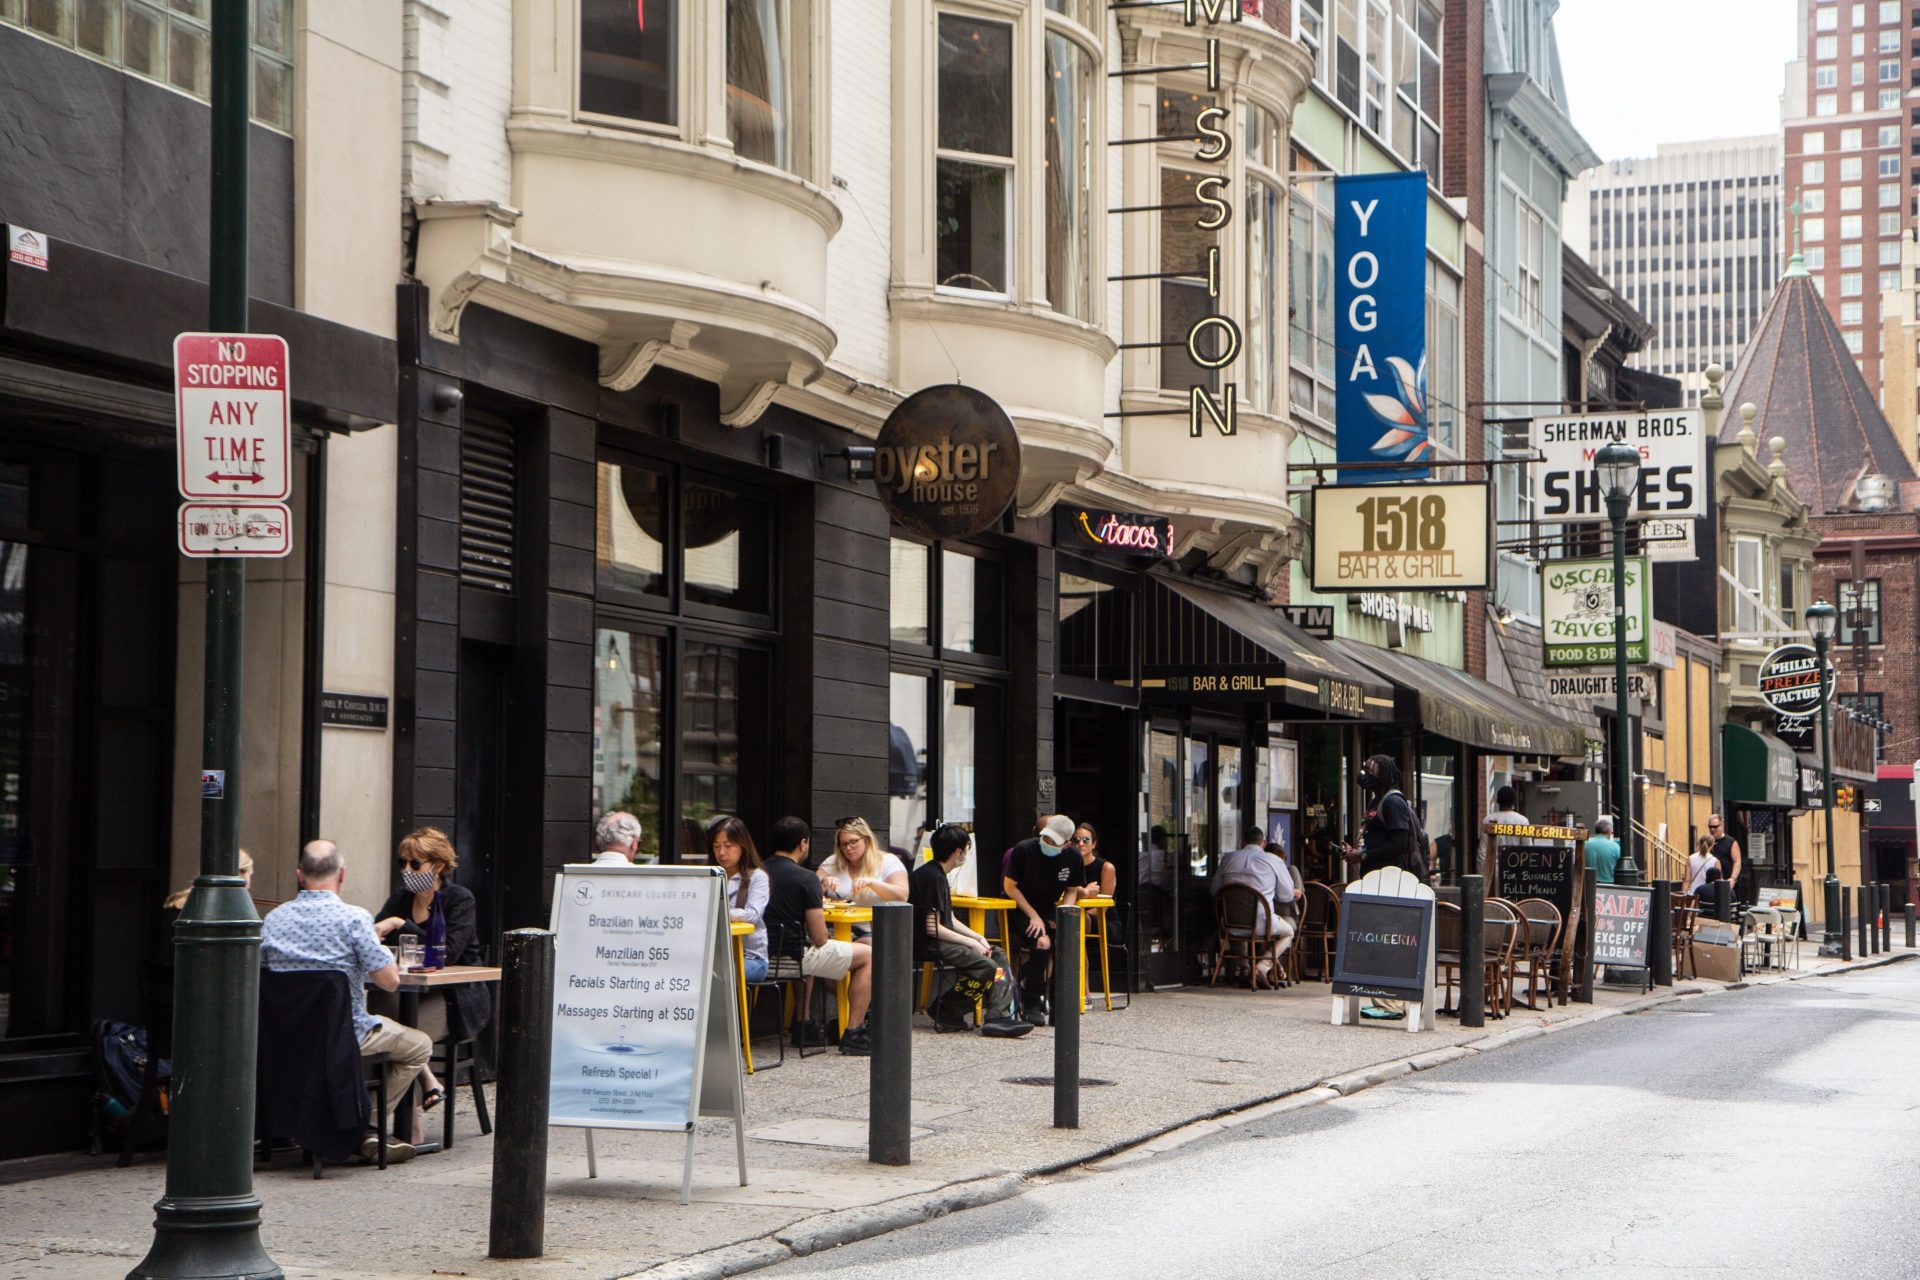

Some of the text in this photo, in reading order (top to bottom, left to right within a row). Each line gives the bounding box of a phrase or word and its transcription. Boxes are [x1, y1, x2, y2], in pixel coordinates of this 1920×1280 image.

[1348, 200, 1379, 382] YOGA
[218, 341, 246, 363] NO
[188, 364, 278, 387] STOPPING
[209, 401, 258, 426] ANY
[1545, 417, 1692, 442] SHERMAN BROS.
[204, 437, 266, 462] TIME
[1583, 444, 1649, 463] M'S
[875, 436, 997, 493] oyster
[913, 480, 978, 502] house
[1544, 466, 1693, 514] SHES
[188, 523, 241, 536] TOW ZONE
[1106, 514, 1158, 548] tacos
[1356, 494, 1446, 552] 1518
[1338, 554, 1463, 579] BAR & GRILL
[1361, 592, 1396, 622] SHOES
[1413, 605, 1434, 632] MEN
[1550, 647, 1643, 661] FOOD & DRNK
[1771, 657, 1817, 675] PHILLY
[1193, 676, 1217, 691] BAR
[1219, 676, 1229, 691] &
[1231, 675, 1265, 690] GRILL
[1550, 676, 1645, 695] DRAUGHT BER
[1764, 671, 1820, 691] PRETZE
[1331, 680, 1343, 709] BAR
[1771, 687, 1821, 704] FACTOR
[1494, 824, 1514, 835] 1518
[1515, 824, 1535, 836] BAR
[1542, 827, 1575, 839] GRILL
[1507, 851, 1552, 868] OPEN
[600, 889, 698, 901] SKINCARE LOUNGE SPA
[1595, 893, 1649, 919] SALE
[588, 914, 684, 930] Brazilian Wax $38
[1623, 920, 1645, 933] OFF
[1595, 932, 1637, 946] EXCEPT
[596, 946, 670, 961] Manzilian $65
[1594, 945, 1631, 959] ALDEN
[569, 975, 691, 993] Facials Starting at $52
[1350, 985, 1397, 997] Mission
[557, 1003, 695, 1022] Massages Starting at $50
[581, 1065, 616, 1078] Refresh
[619, 1067, 651, 1081] Special
